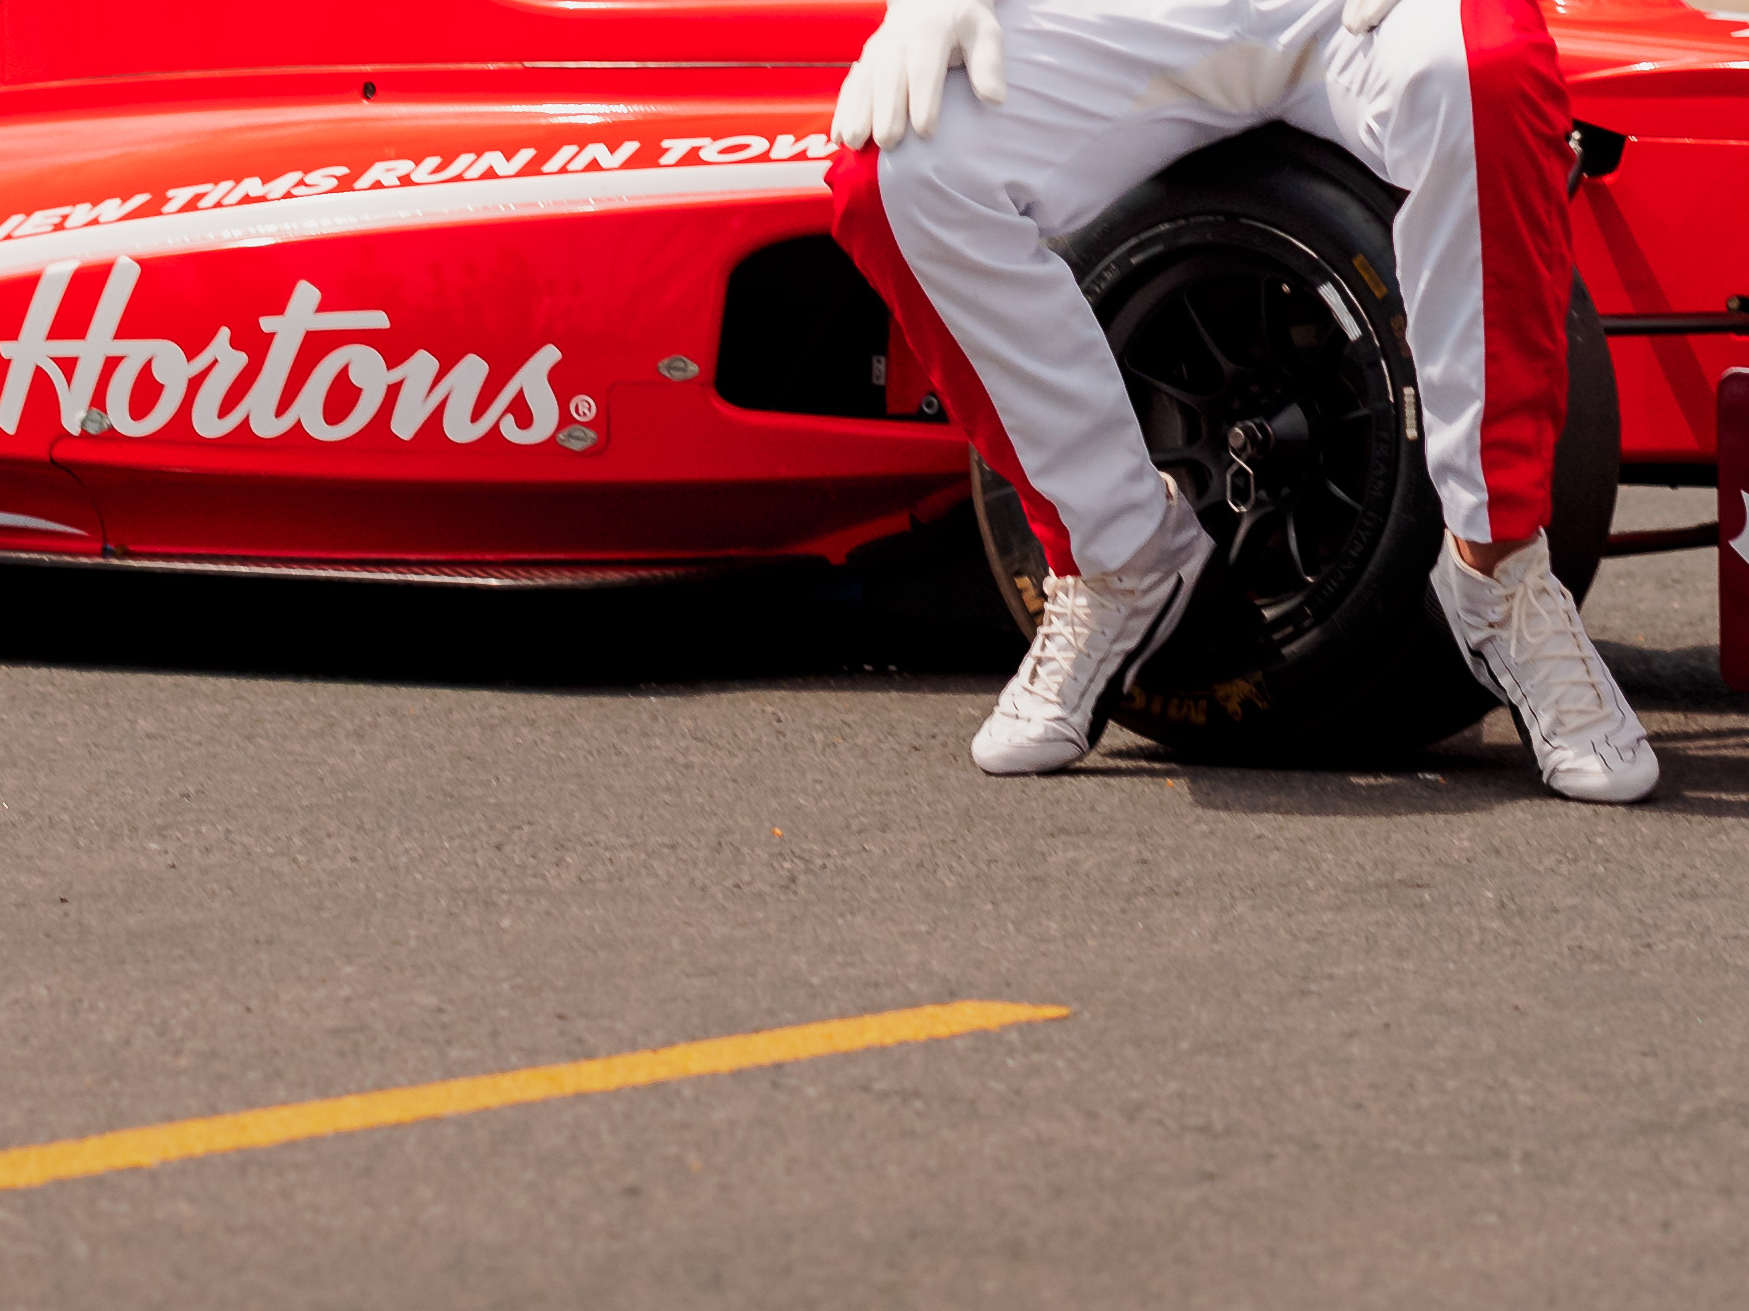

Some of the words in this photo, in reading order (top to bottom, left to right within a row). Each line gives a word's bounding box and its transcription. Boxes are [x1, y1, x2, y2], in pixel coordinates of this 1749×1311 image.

[161, 165, 351, 214] TIMS
[352, 147, 536, 190] RUN
[542, 140, 641, 173] IN
[658, 134, 843, 165] TOW
